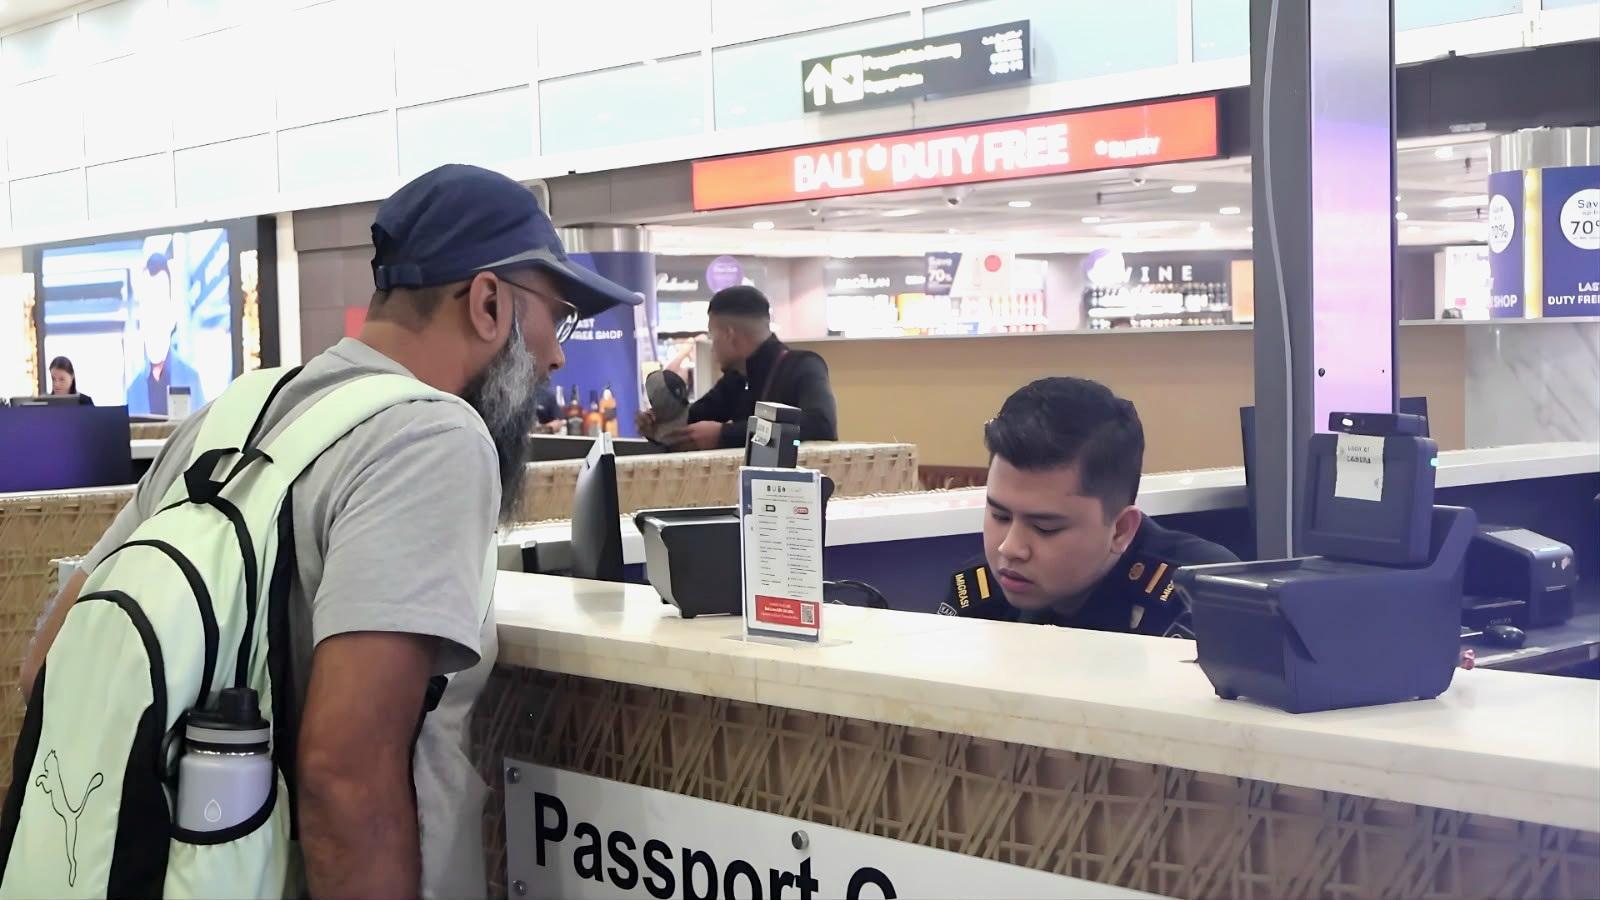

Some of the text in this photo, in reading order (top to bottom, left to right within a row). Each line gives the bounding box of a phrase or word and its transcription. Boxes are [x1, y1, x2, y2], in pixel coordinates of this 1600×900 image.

[793, 123, 1069, 193] BALI DUTY FREE
[1577, 199, 1600, 209] Sav
[1578, 281, 1600, 292] LAS
[1493, 294, 1518, 308] SHOP
[1547, 294, 1600, 305] DUTY FRE
[595, 330, 623, 340] SHOP
[955, 573, 970, 609] IMIGRASI
[534, 791, 819, 900] Passport
